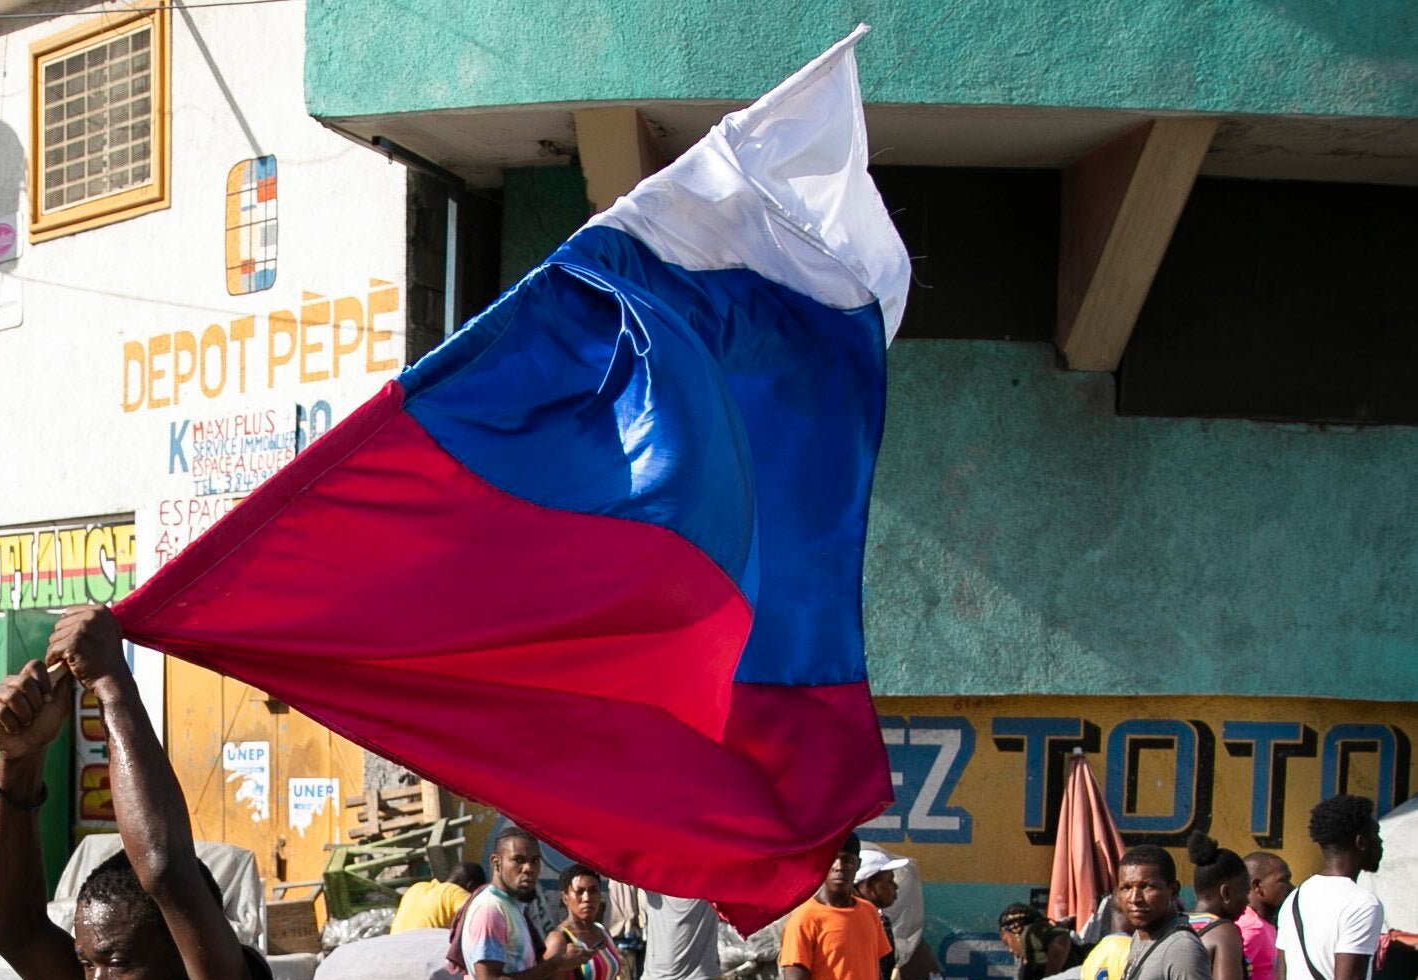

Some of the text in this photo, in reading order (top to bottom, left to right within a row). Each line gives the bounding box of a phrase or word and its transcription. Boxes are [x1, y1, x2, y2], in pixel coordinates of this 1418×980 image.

[122, 315, 256, 413] DEPOT
[193, 410, 276, 441] MAXI PLUS
[193, 438, 237, 459] SERVICE
[192, 449, 292, 477] ESPACE A LOUER
[227, 749, 265, 761] UNEP
[293, 785, 334, 797] UNEP
